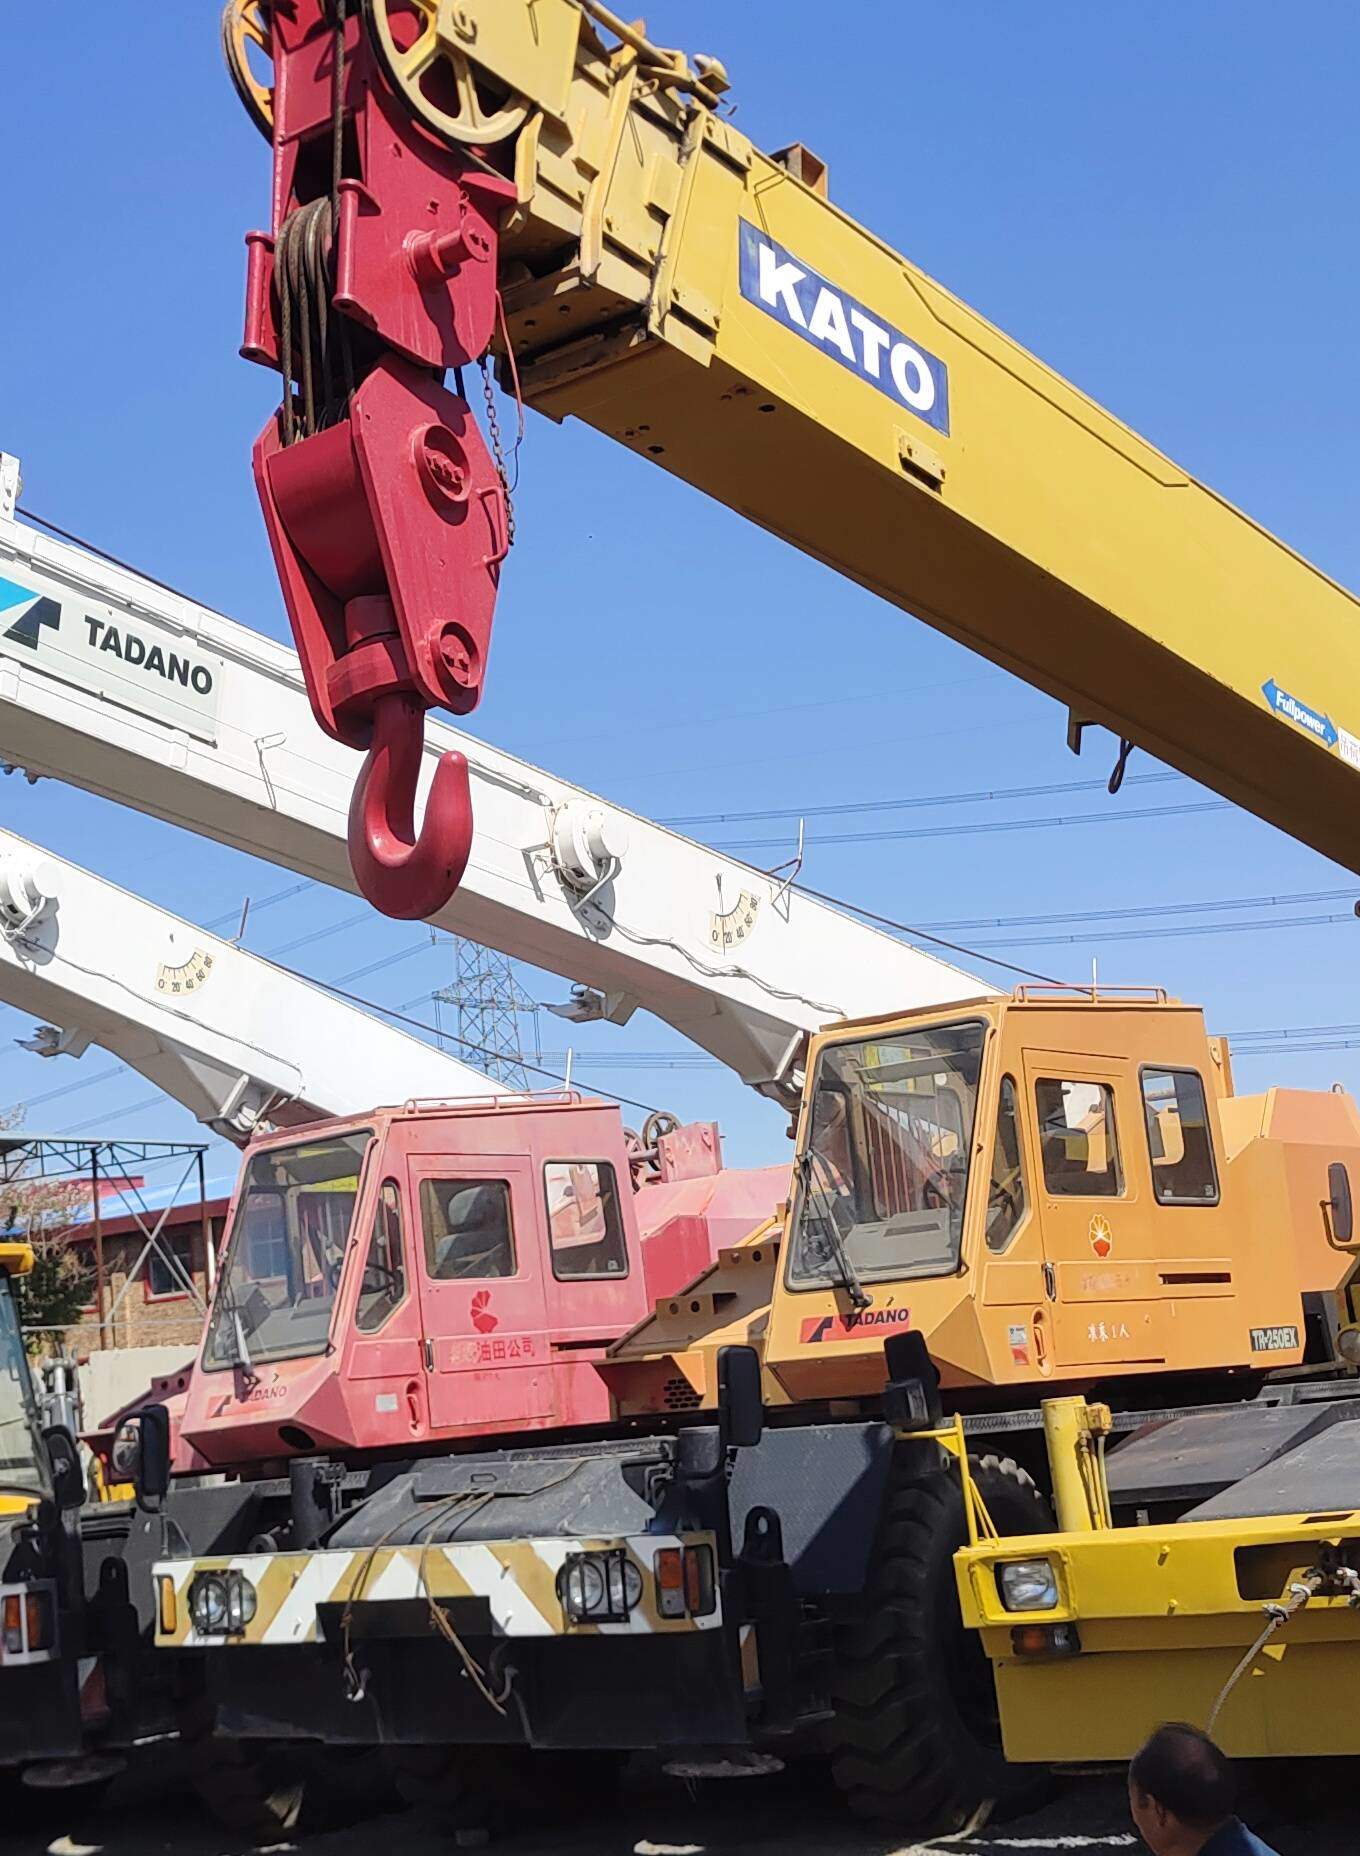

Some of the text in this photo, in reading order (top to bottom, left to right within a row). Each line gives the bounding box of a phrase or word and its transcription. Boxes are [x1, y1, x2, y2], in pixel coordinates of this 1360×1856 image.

[759, 242, 935, 411] KATO
[84, 614, 213, 695] TADANO
[1275, 689, 1326, 735] Fullpower
[476, 1337, 535, 1363] 油田公司
[1251, 1327, 1298, 1351] TR-250EX
